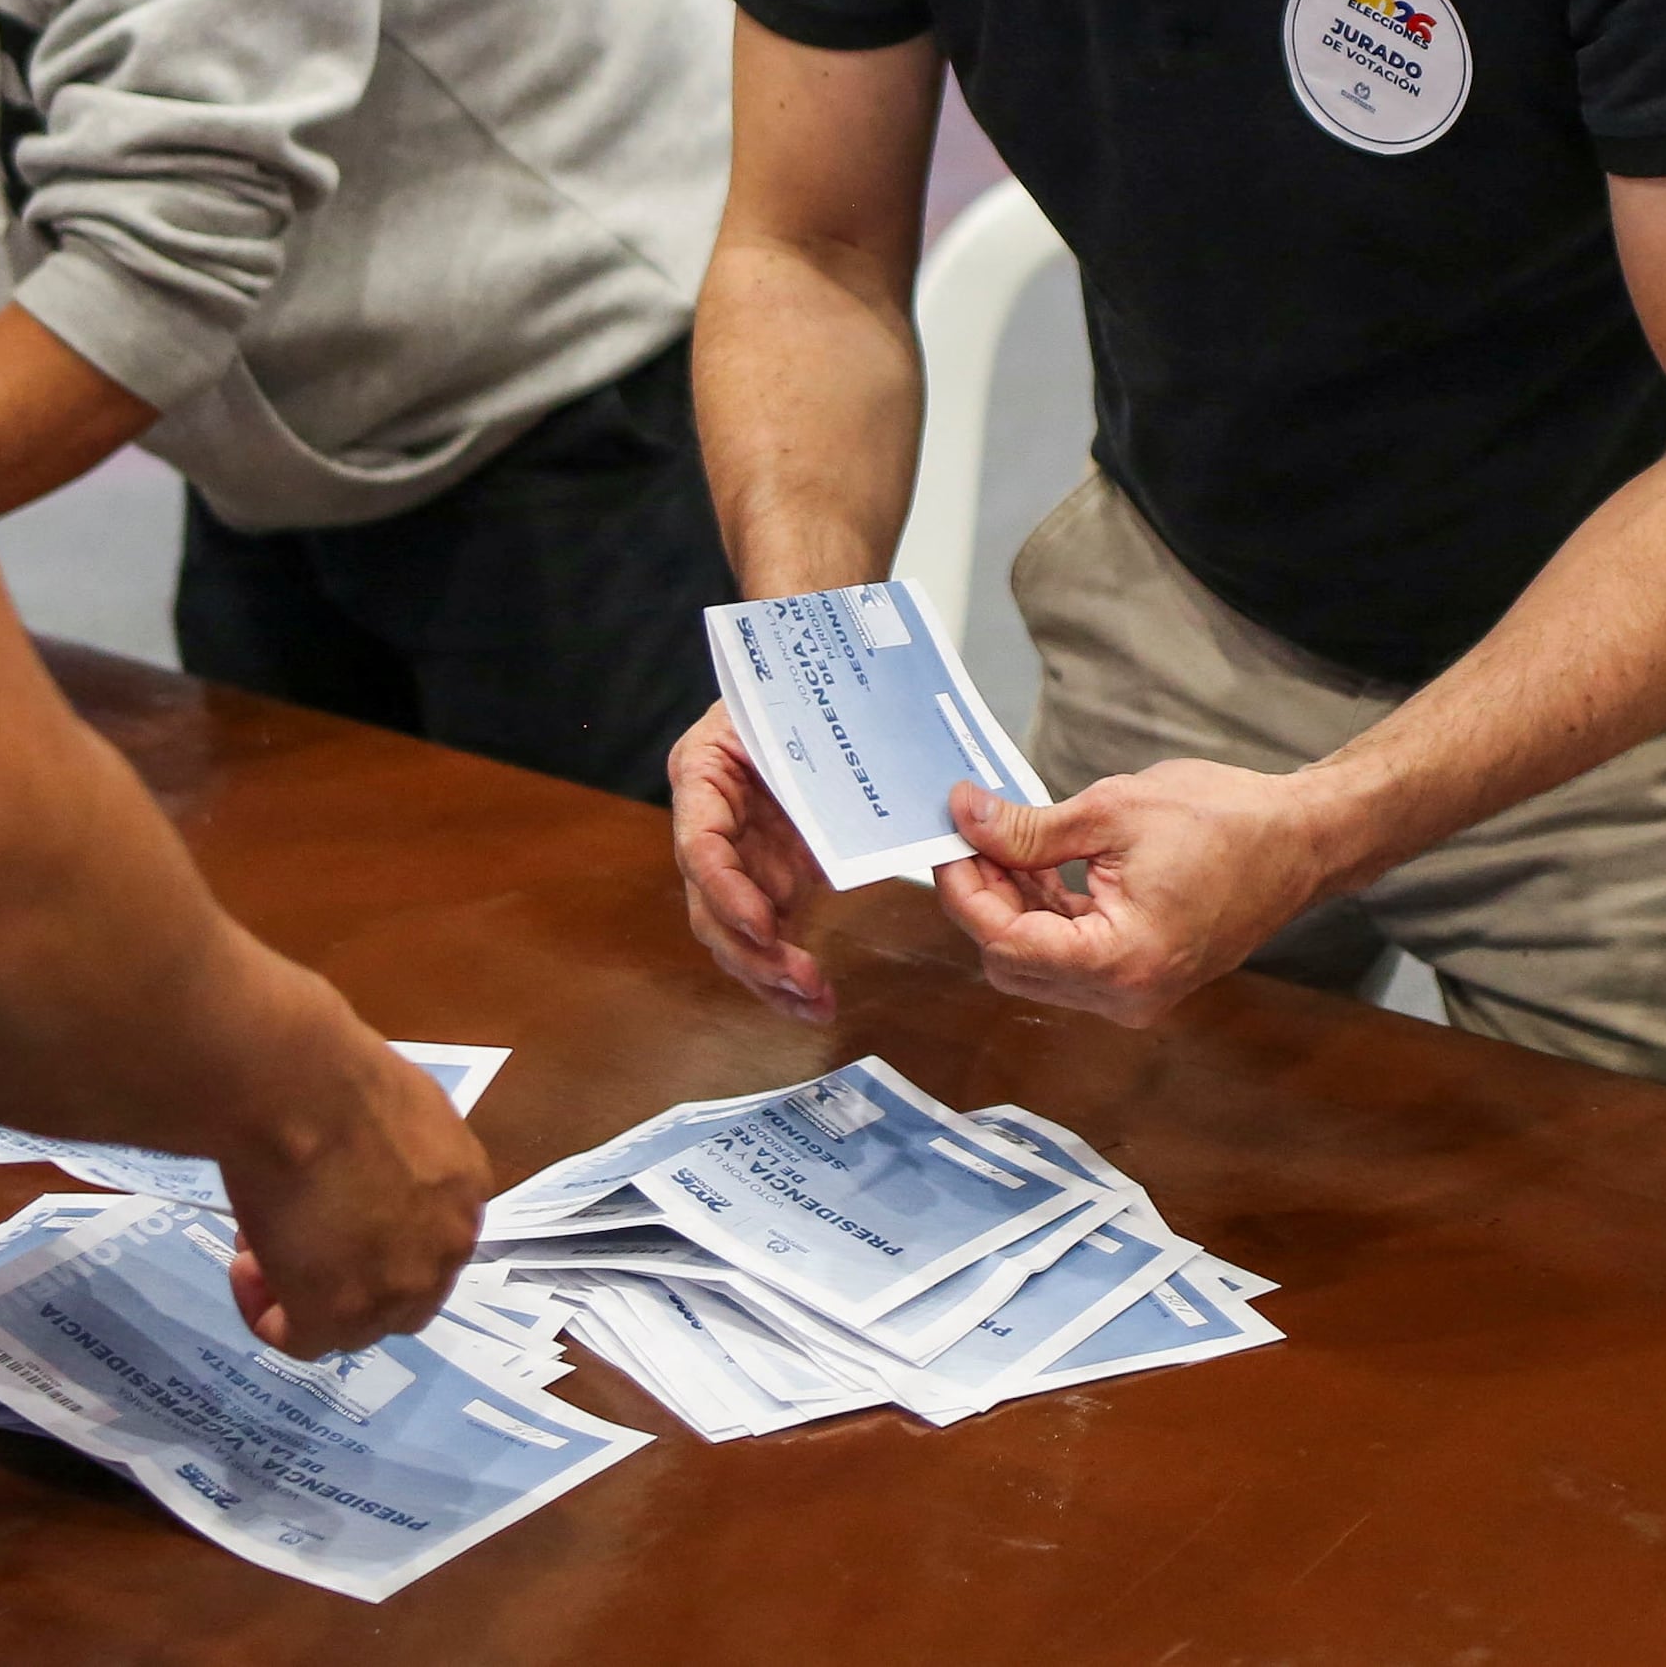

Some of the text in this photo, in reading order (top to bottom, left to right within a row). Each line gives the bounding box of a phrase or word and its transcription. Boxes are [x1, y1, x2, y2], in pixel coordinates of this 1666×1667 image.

[1321, 34, 1421, 98] DE VOTACIÓN
[1330, 17, 1423, 80] JURADO
[774, 630, 792, 661] POR
[802, 597, 836, 660] PERIODO
[802, 627, 819, 653] LA
[788, 665, 811, 706] VOTO
[816, 659, 835, 685] DE
[793, 641, 890, 817] PRESIDENCIA
[749, 1123, 803, 1163] PERIODO
[757, 1146, 780, 1166] LA
[706, 1149, 784, 1209] VOTO POR LA
[780, 1165, 808, 1184] DE
[750, 1160, 904, 1257] PRESIDENCIA
[40, 1302, 246, 1451] VICEPRESIDENCIA
[253, 1354, 363, 1424] INSTRUCCIONES PARA VOTAR
[271, 1444, 294, 1461] LA
[296, 1456, 325, 1473] DE
[262, 1457, 431, 1531] PRESIDENCIA
